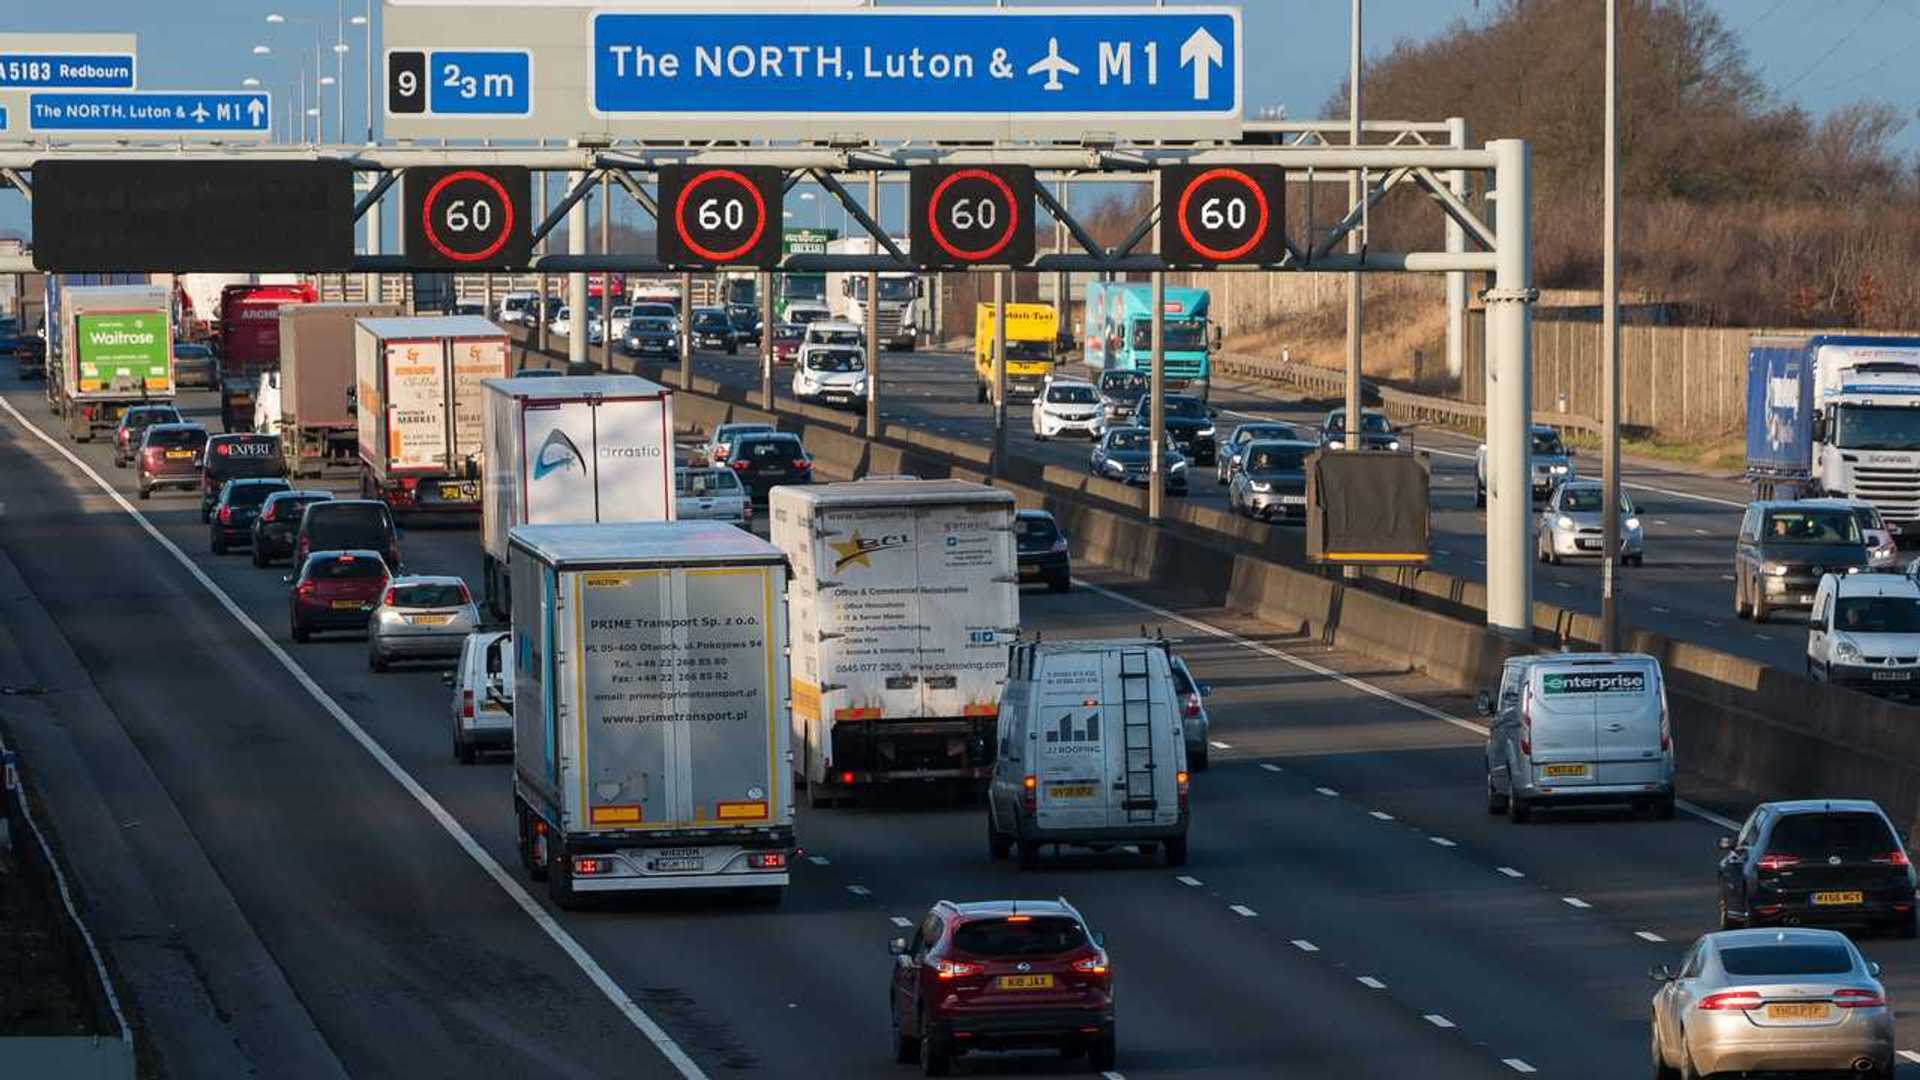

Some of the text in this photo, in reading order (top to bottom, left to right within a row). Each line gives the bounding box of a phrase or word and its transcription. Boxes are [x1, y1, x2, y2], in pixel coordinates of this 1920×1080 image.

[59, 63, 129, 78] Redbourn
[609, 45, 679, 77] The
[695, 45, 854, 81] NORTH,
[864, 46, 973, 78] Luton
[989, 47, 1014, 79] &
[398, 70, 417, 97] 9
[484, 74, 514, 97] m
[34, 103, 62, 118] The
[129, 104, 171, 119] Luton
[175, 105, 186, 119] &
[446, 199, 491, 231] 60
[698, 198, 744, 231] 60
[951, 198, 996, 230] 60
[1201, 197, 1246, 229] 60
[89, 330, 155, 346] Waitrose
[228, 443, 273, 457] EXPERT
[590, 618, 632, 630] PRIME
[636, 615, 697, 630] Transport
[701, 614, 722, 629] Sp.
[659, 673, 673, 682] 22
[1550, 674, 1643, 690] enterprise
[602, 710, 748, 725] www.primetransport.pl
